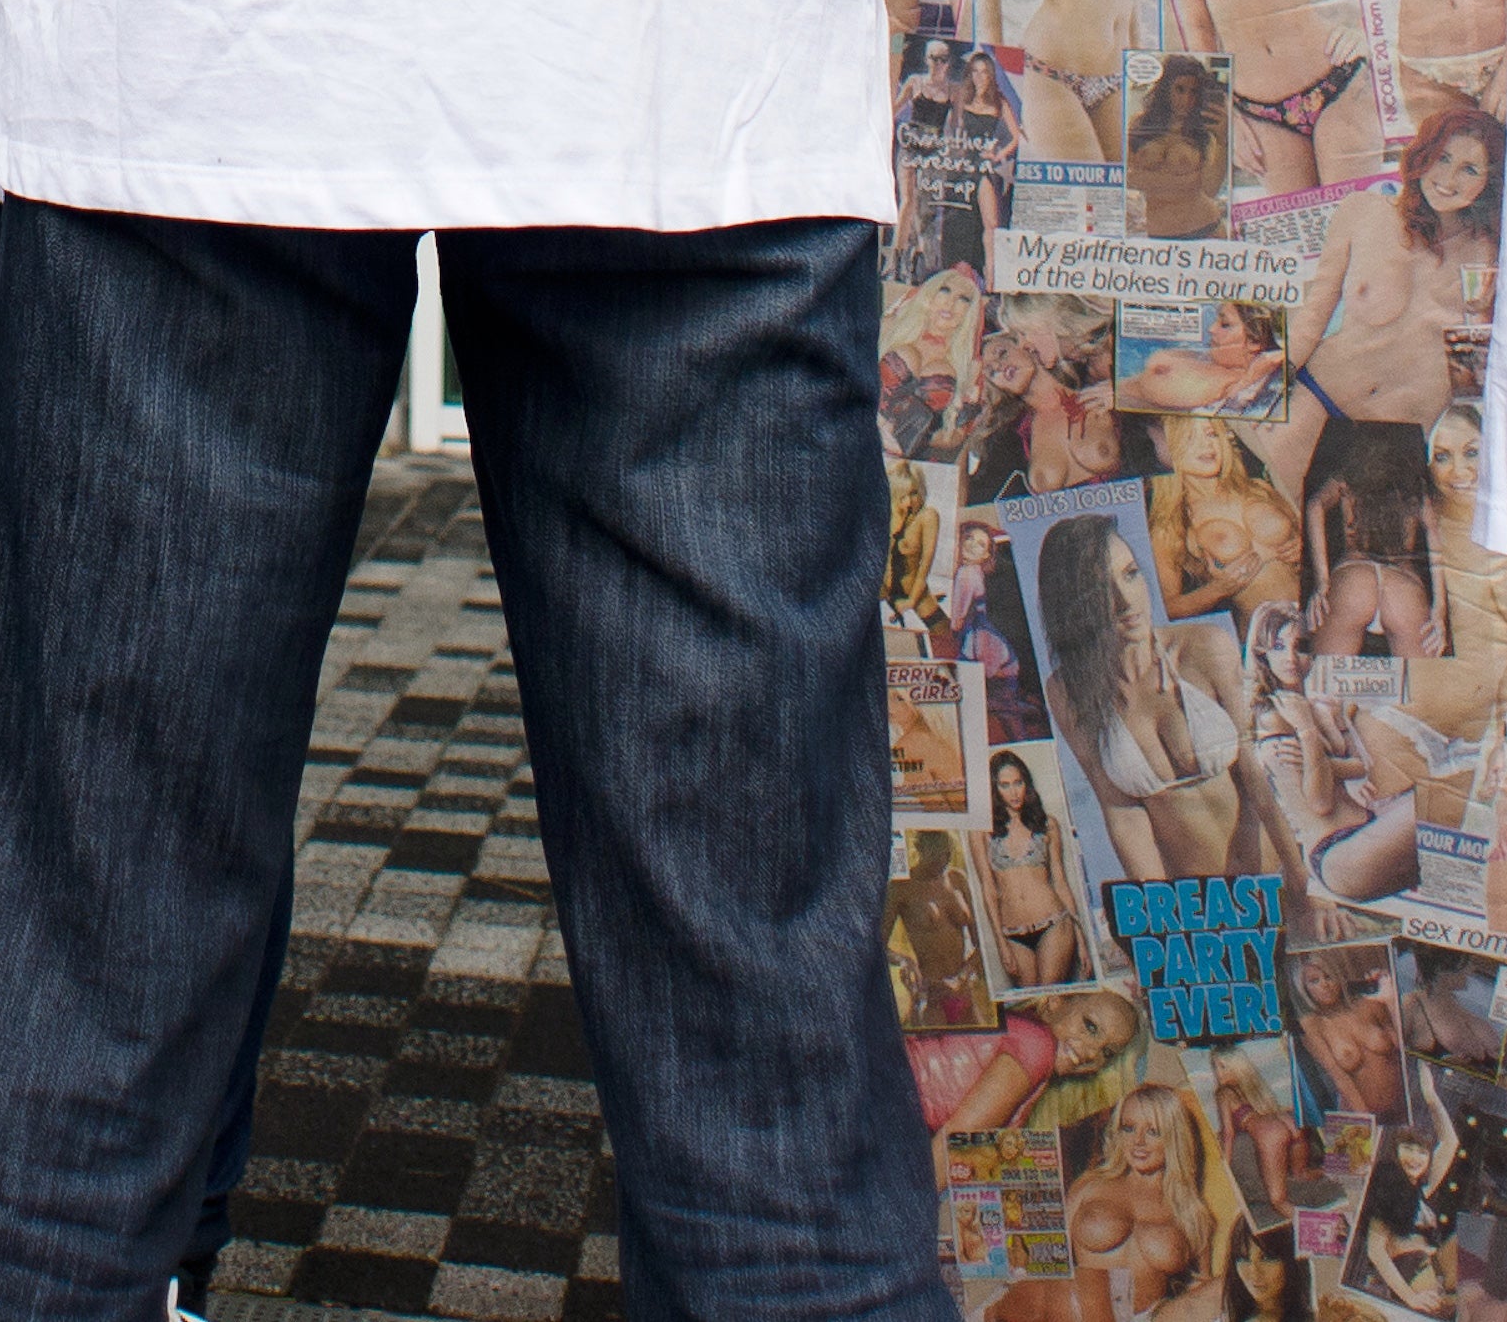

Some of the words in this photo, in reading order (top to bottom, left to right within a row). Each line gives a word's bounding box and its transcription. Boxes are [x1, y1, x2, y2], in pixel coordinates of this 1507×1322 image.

[1019, 234, 1054, 270] My
[1063, 237, 1192, 270] girlfriend's
[1199, 245, 1248, 272] had
[1255, 249, 1298, 276] five
[1018, 264, 1041, 288] of
[1046, 265, 1086, 289] the
[1092, 268, 1170, 296] blokes
[1177, 272, 1198, 297] in
[1205, 279, 1246, 299] our
[1005, 495, 1070, 525] 2013
[1075, 481, 1141, 514] looks
[1112, 874, 1284, 937] BREAST
[1407, 918, 1453, 943] sex
[1132, 927, 1279, 987] PARTY
[1150, 980, 1283, 1041] EVER!
